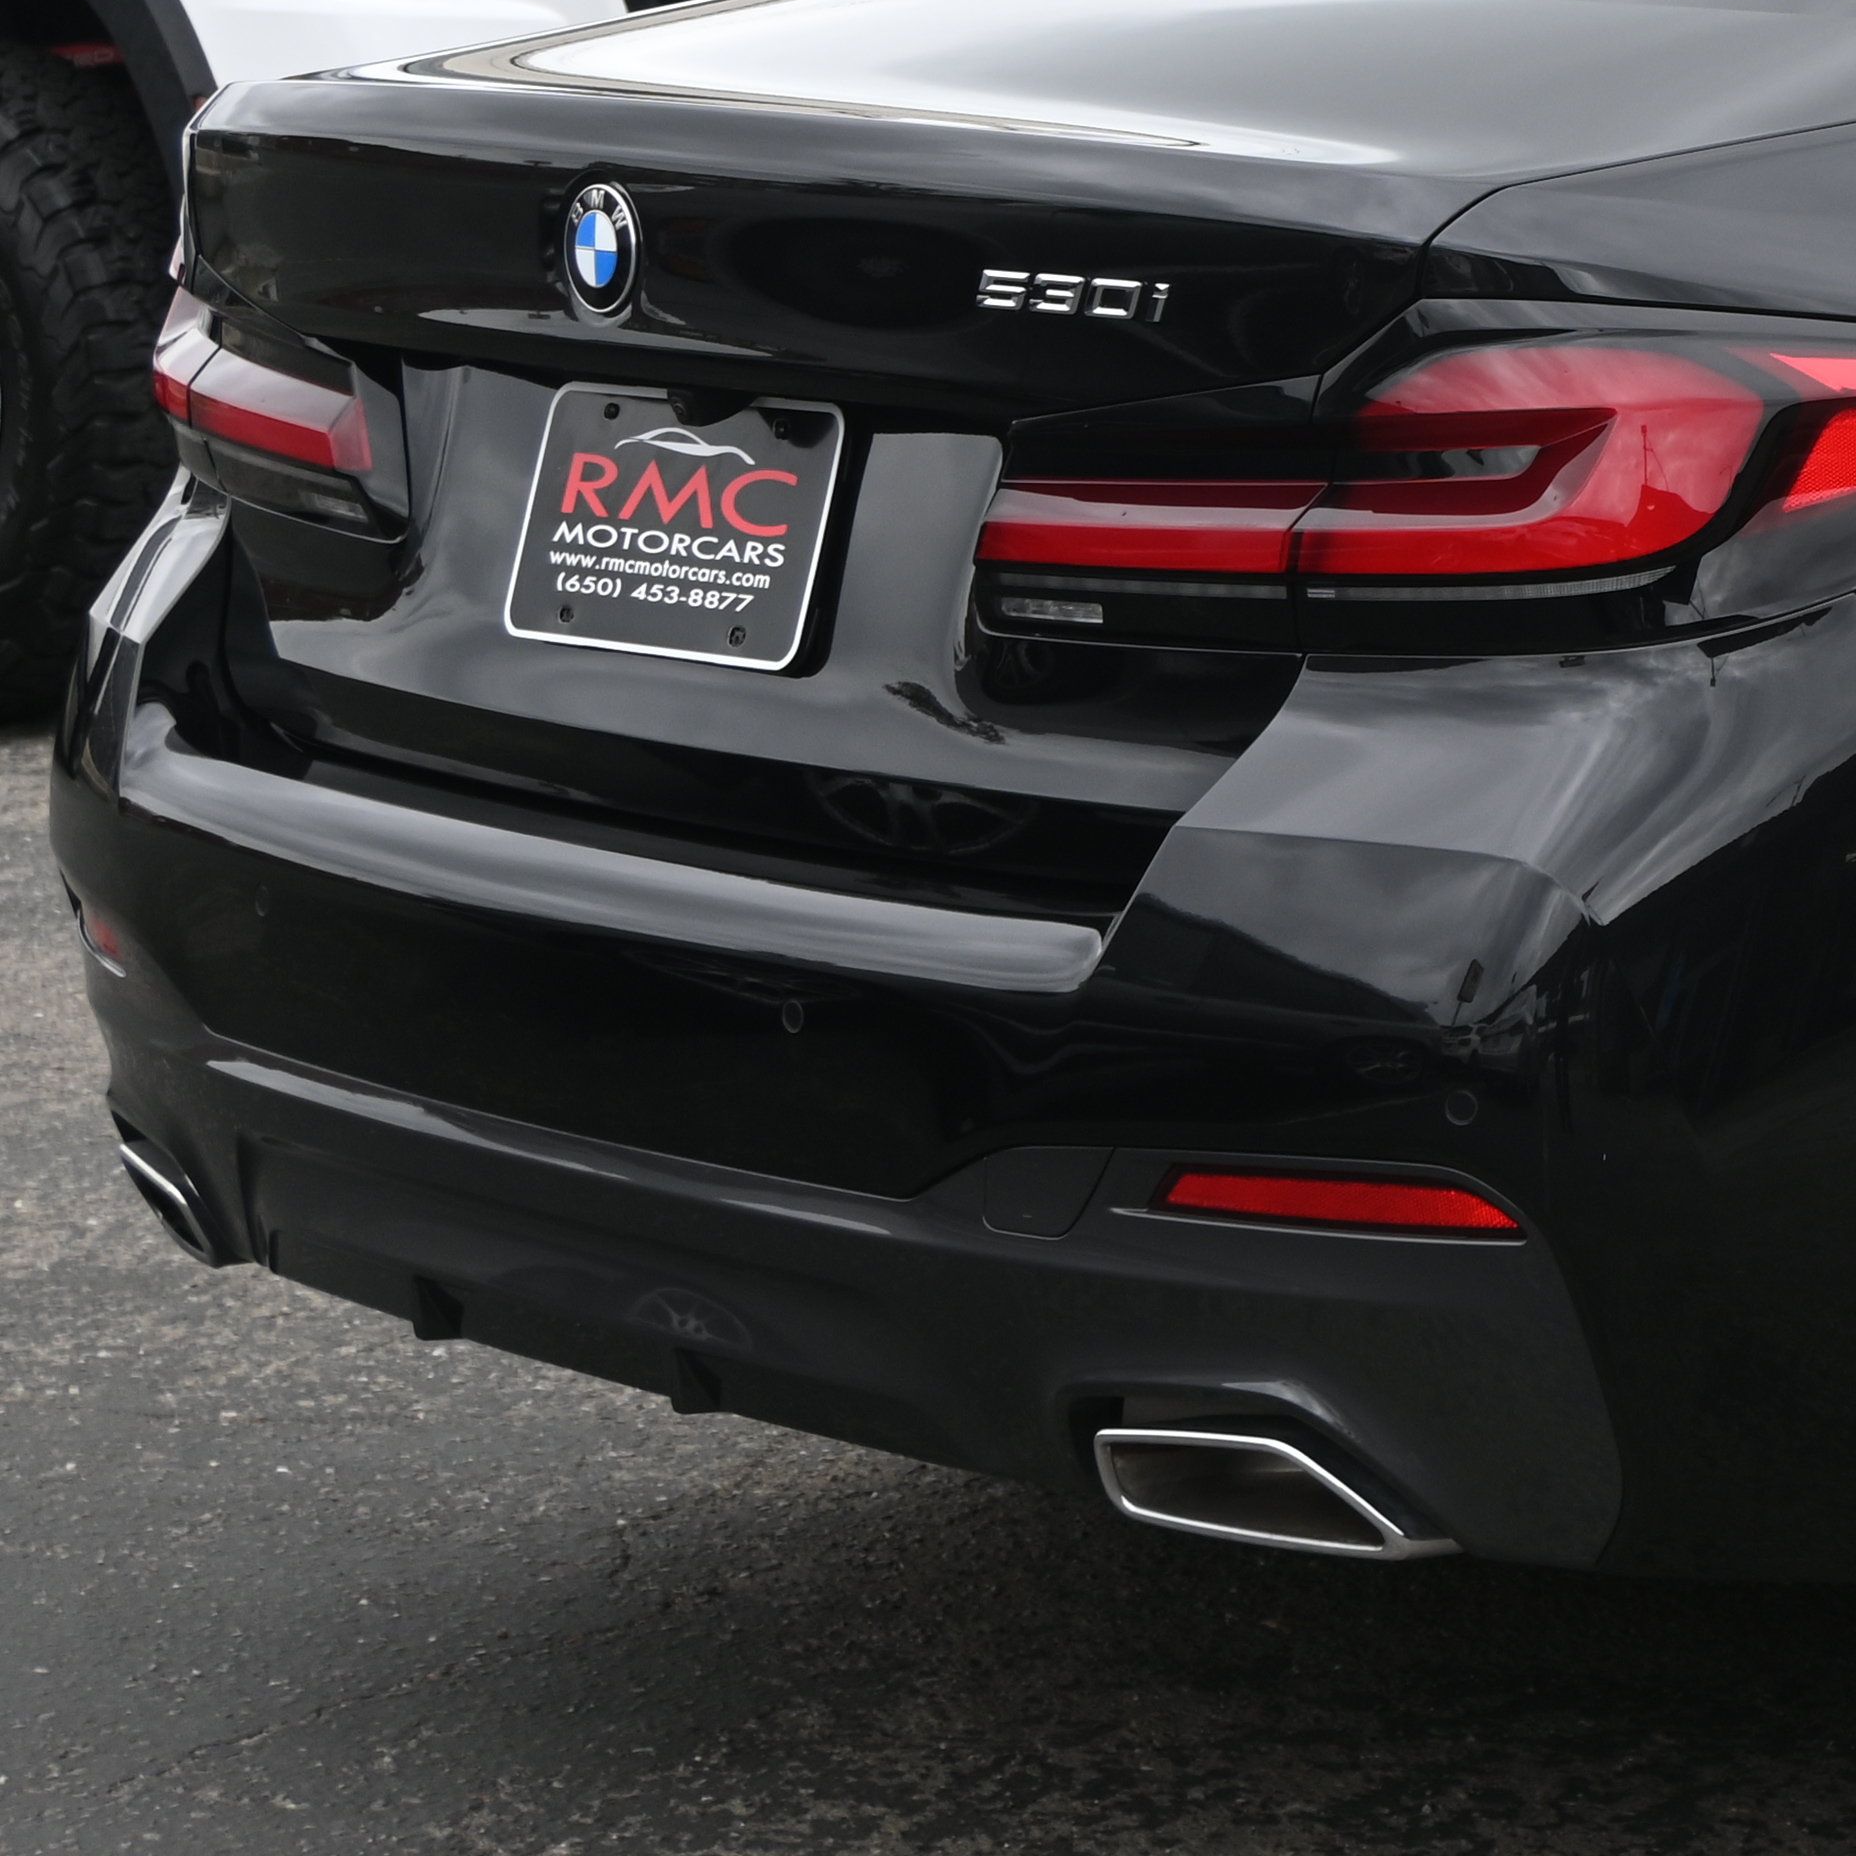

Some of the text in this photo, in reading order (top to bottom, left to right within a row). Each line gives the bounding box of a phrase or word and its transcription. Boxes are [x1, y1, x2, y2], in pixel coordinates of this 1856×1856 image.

[571, 189, 627, 230] BMW
[976, 269, 1170, 322] 530i
[561, 452, 798, 537] RMC
[552, 520, 786, 567] MOTORCARS
[549, 550, 771, 589] www.rmcmotorcars.com
[557, 572, 754, 612] (650) 453-8877
